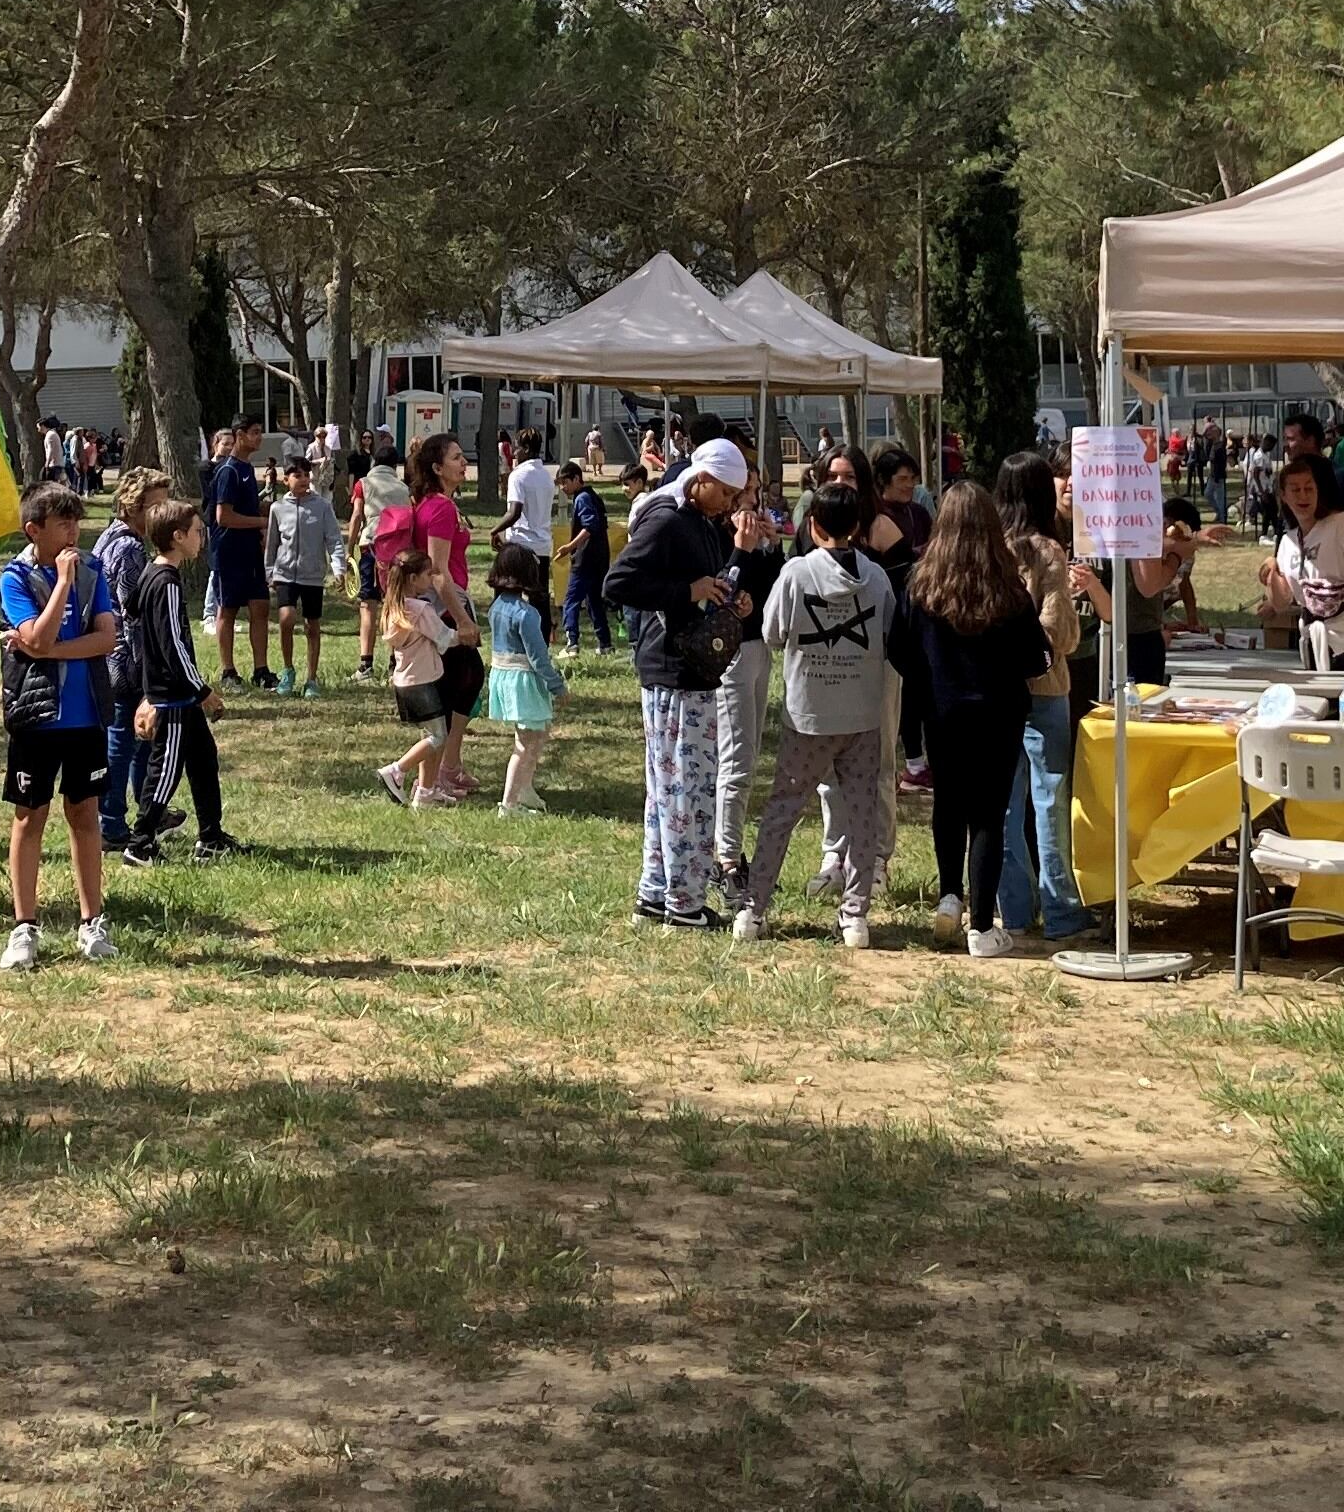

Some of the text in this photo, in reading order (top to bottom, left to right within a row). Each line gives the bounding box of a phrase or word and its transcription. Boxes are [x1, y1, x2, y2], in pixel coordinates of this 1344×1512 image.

[1081, 463, 1153, 478] CAMBIAMOS
[1082, 488, 1154, 504] BASURA POR
[1085, 514, 1154, 529] CORAZONES
